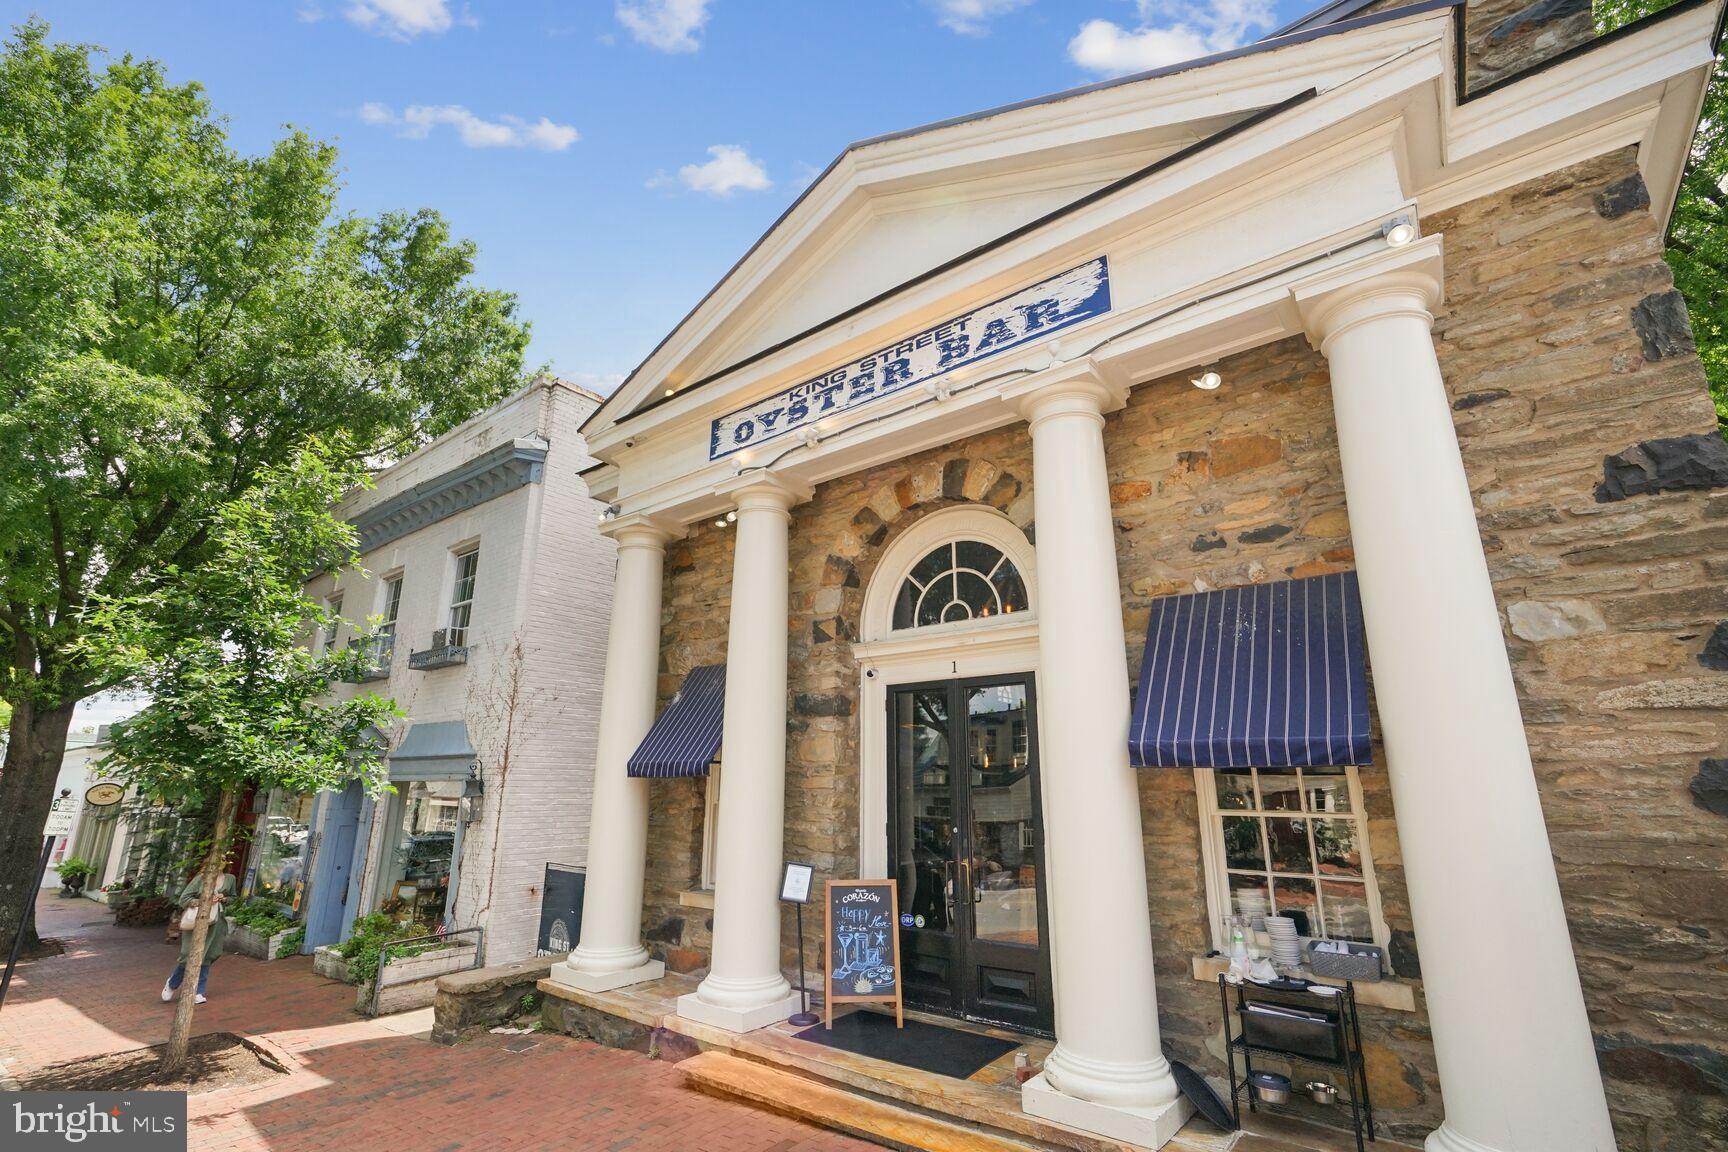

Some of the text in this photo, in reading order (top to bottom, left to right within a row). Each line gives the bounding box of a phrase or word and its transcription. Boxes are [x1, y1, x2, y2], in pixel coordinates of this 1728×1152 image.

[789, 316, 973, 402] KING STREET
[733, 298, 1066, 446] OYSTER BAR
[951, 660, 958, 674] 1
[52, 800, 60, 810] 3
[841, 906, 871, 923] Happy
